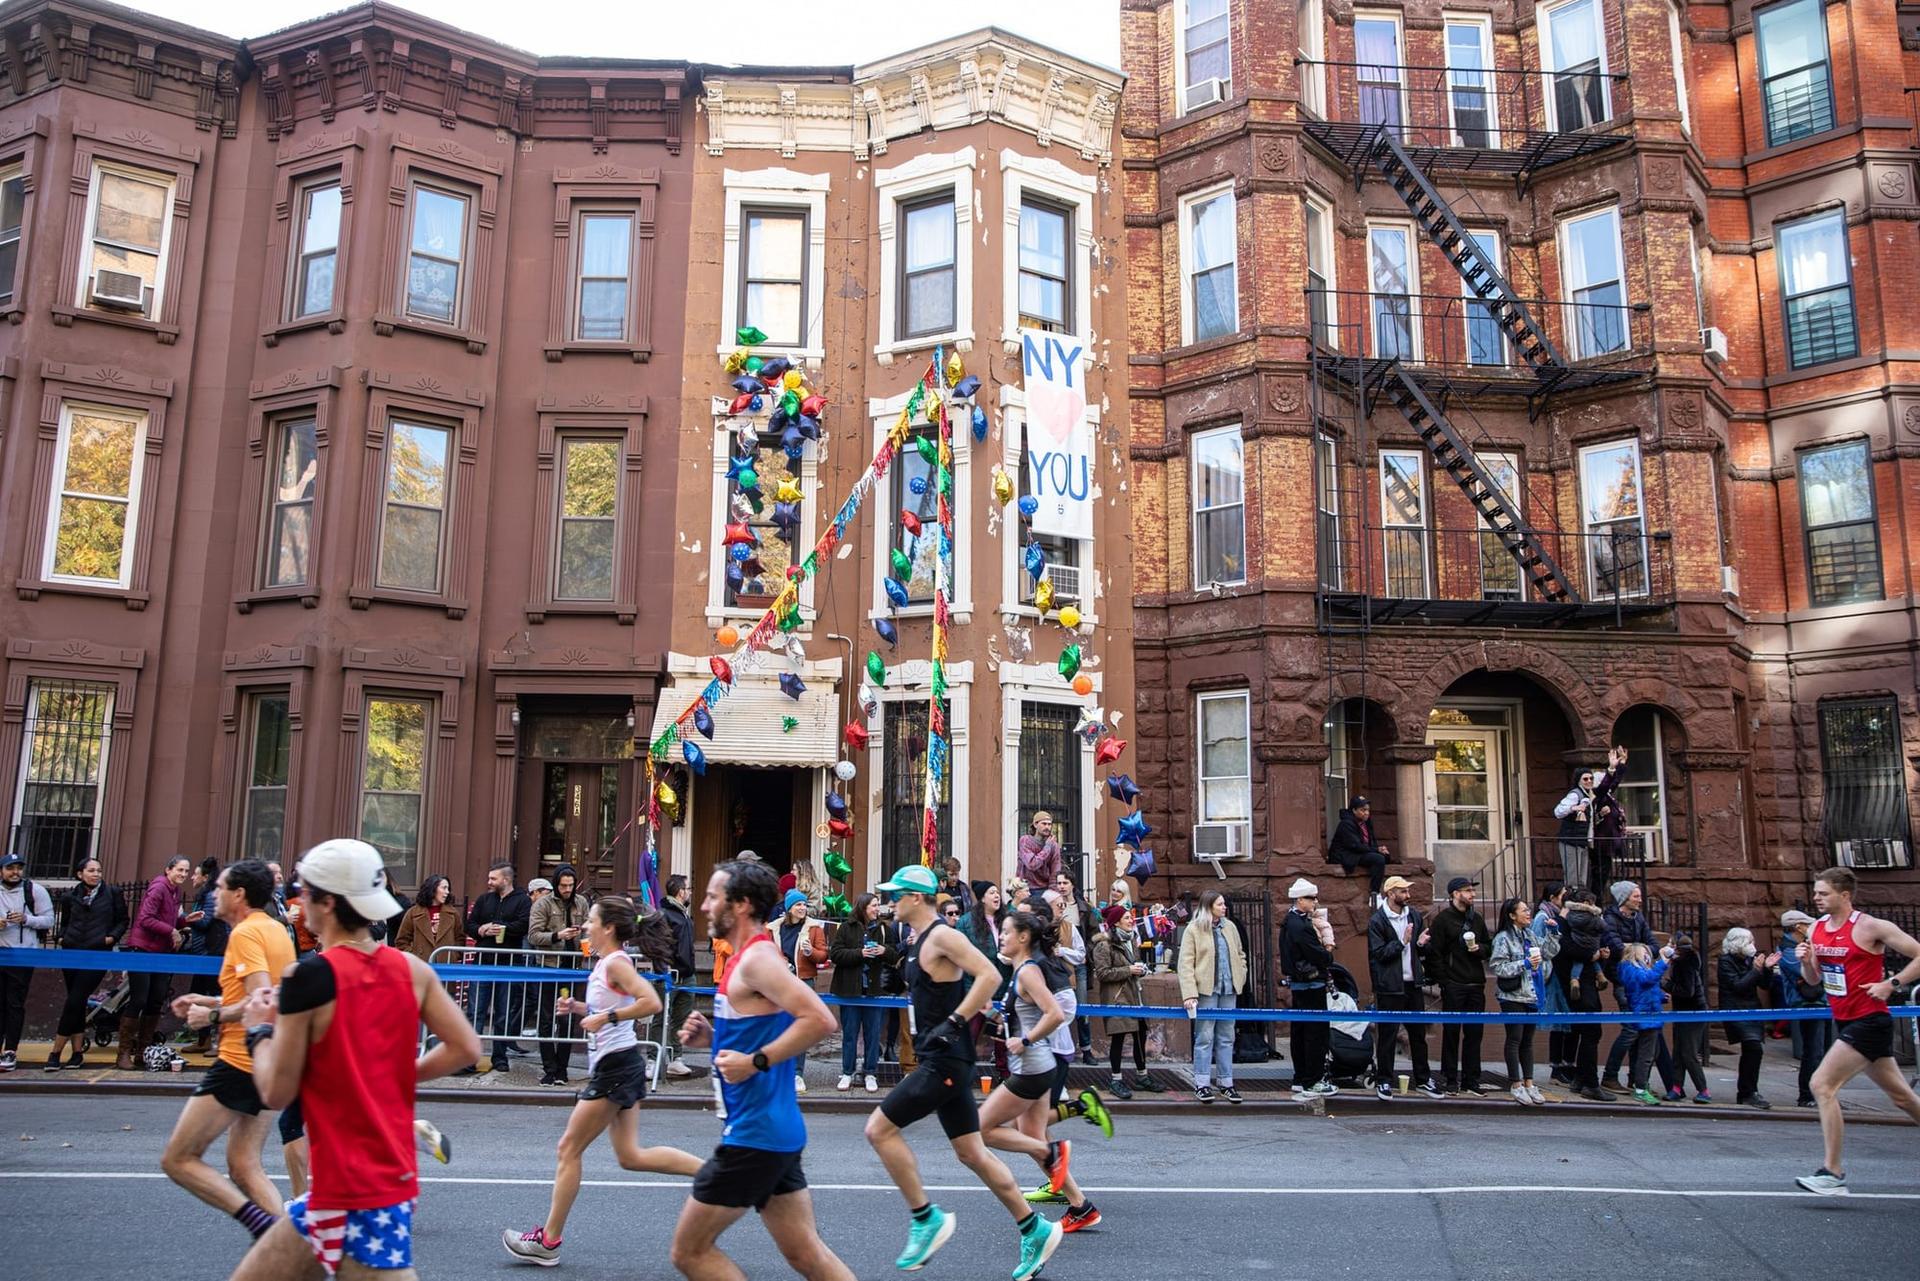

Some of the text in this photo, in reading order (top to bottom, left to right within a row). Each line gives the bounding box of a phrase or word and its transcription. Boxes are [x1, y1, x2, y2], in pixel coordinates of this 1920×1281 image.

[1023, 334, 1083, 388] NY
[1028, 450, 1089, 502] YOU
[1813, 943, 1850, 957] MARIST
